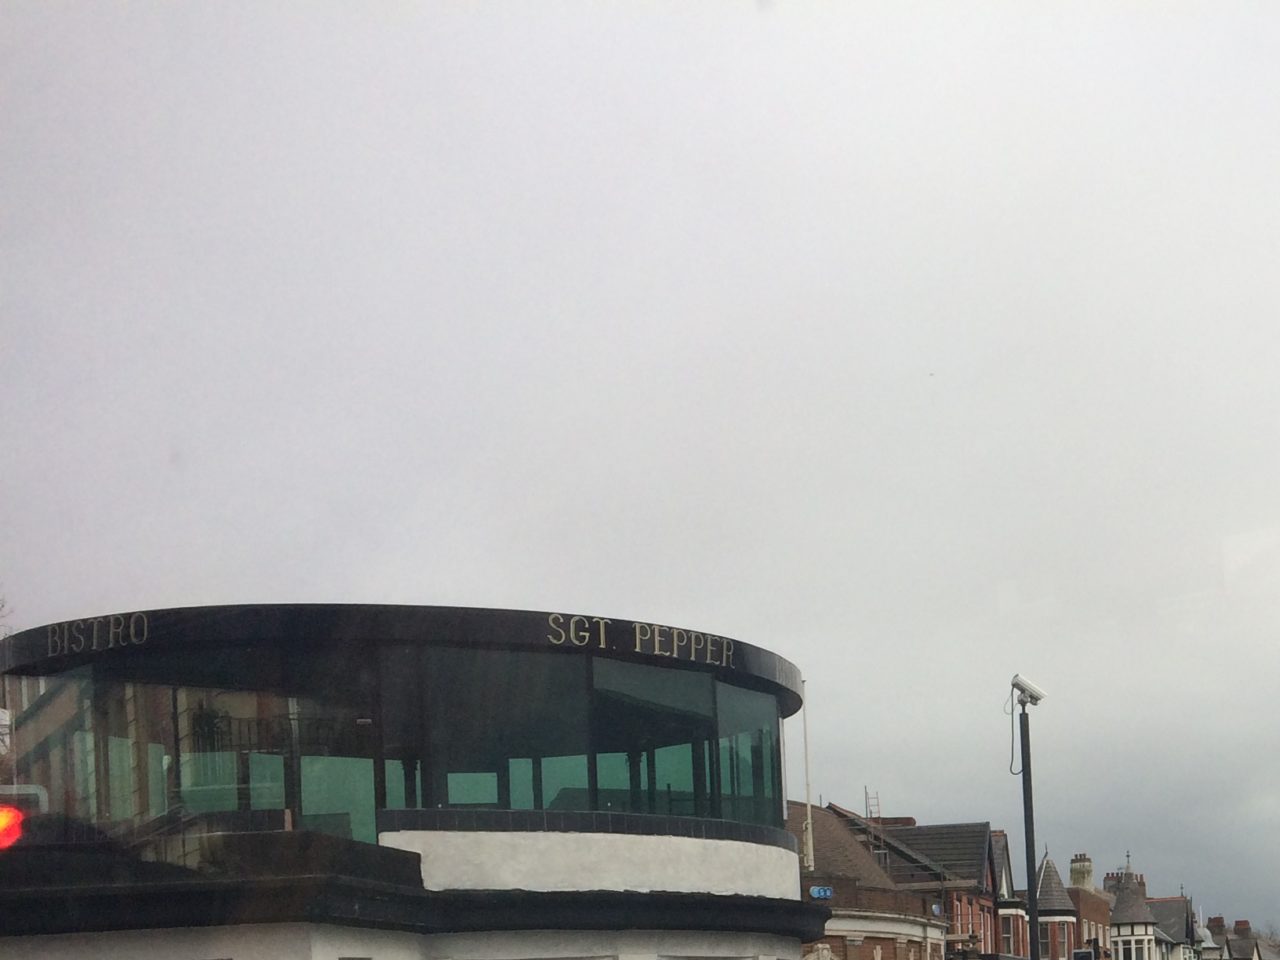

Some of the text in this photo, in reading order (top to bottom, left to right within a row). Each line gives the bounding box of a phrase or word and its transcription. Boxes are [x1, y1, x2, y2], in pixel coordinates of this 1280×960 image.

[47, 612, 148, 657] BISTRO
[547, 613, 736, 669] SGT. PEPPER
